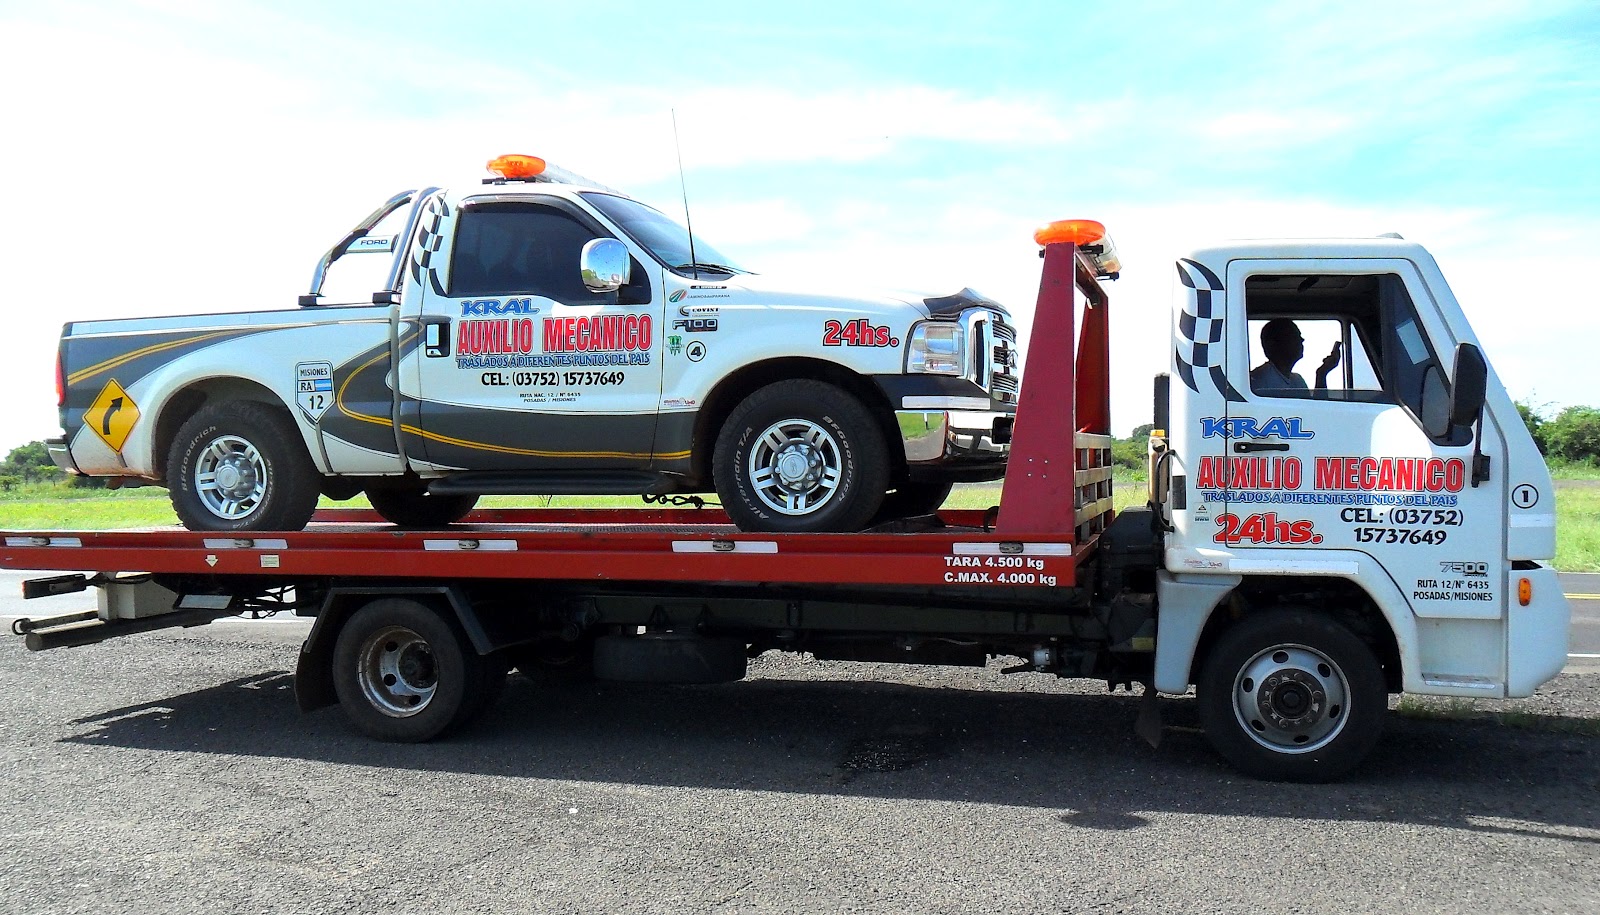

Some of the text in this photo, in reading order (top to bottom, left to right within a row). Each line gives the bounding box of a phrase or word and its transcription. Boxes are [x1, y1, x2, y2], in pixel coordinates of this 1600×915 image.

[460, 298, 539, 316] KRAL
[456, 314, 653, 355] AUXILIO MECANICO
[823, 319, 900, 348] 24hs.
[690, 346, 702, 357] 4
[456, 351, 650, 369] TRASLADOS A DIFERENTES PUNTOS DEL PAIS
[300, 368, 328, 377] MISIONES
[481, 371, 625, 387] CEL: (03752) 15737649
[300, 382, 313, 391] RA
[309, 394, 324, 410] 12
[1200, 416, 1315, 440] KRAL
[1196, 456, 1465, 493] AUXILIO MECANICO
[1201, 491, 1458, 507] TRASLADOS A DIFERENTES PUNTOS DEL PAIS
[1522, 490, 1528, 502] 1
[1340, 507, 1464, 526] CEL: (03752)
[1212, 512, 1323, 545] 24hs.
[1354, 527, 1447, 545] 15737649
[944, 556, 1044, 570] TARA 4.500 kg
[1440, 562, 1489, 573] 7500
[944, 572, 1057, 587] C.MAX. 4.000 kg
[1417, 580, 1438, 588] RUTA
[1467, 581, 1489, 589] 6435
[1413, 592, 1493, 601] POSADAS/MISIONES
